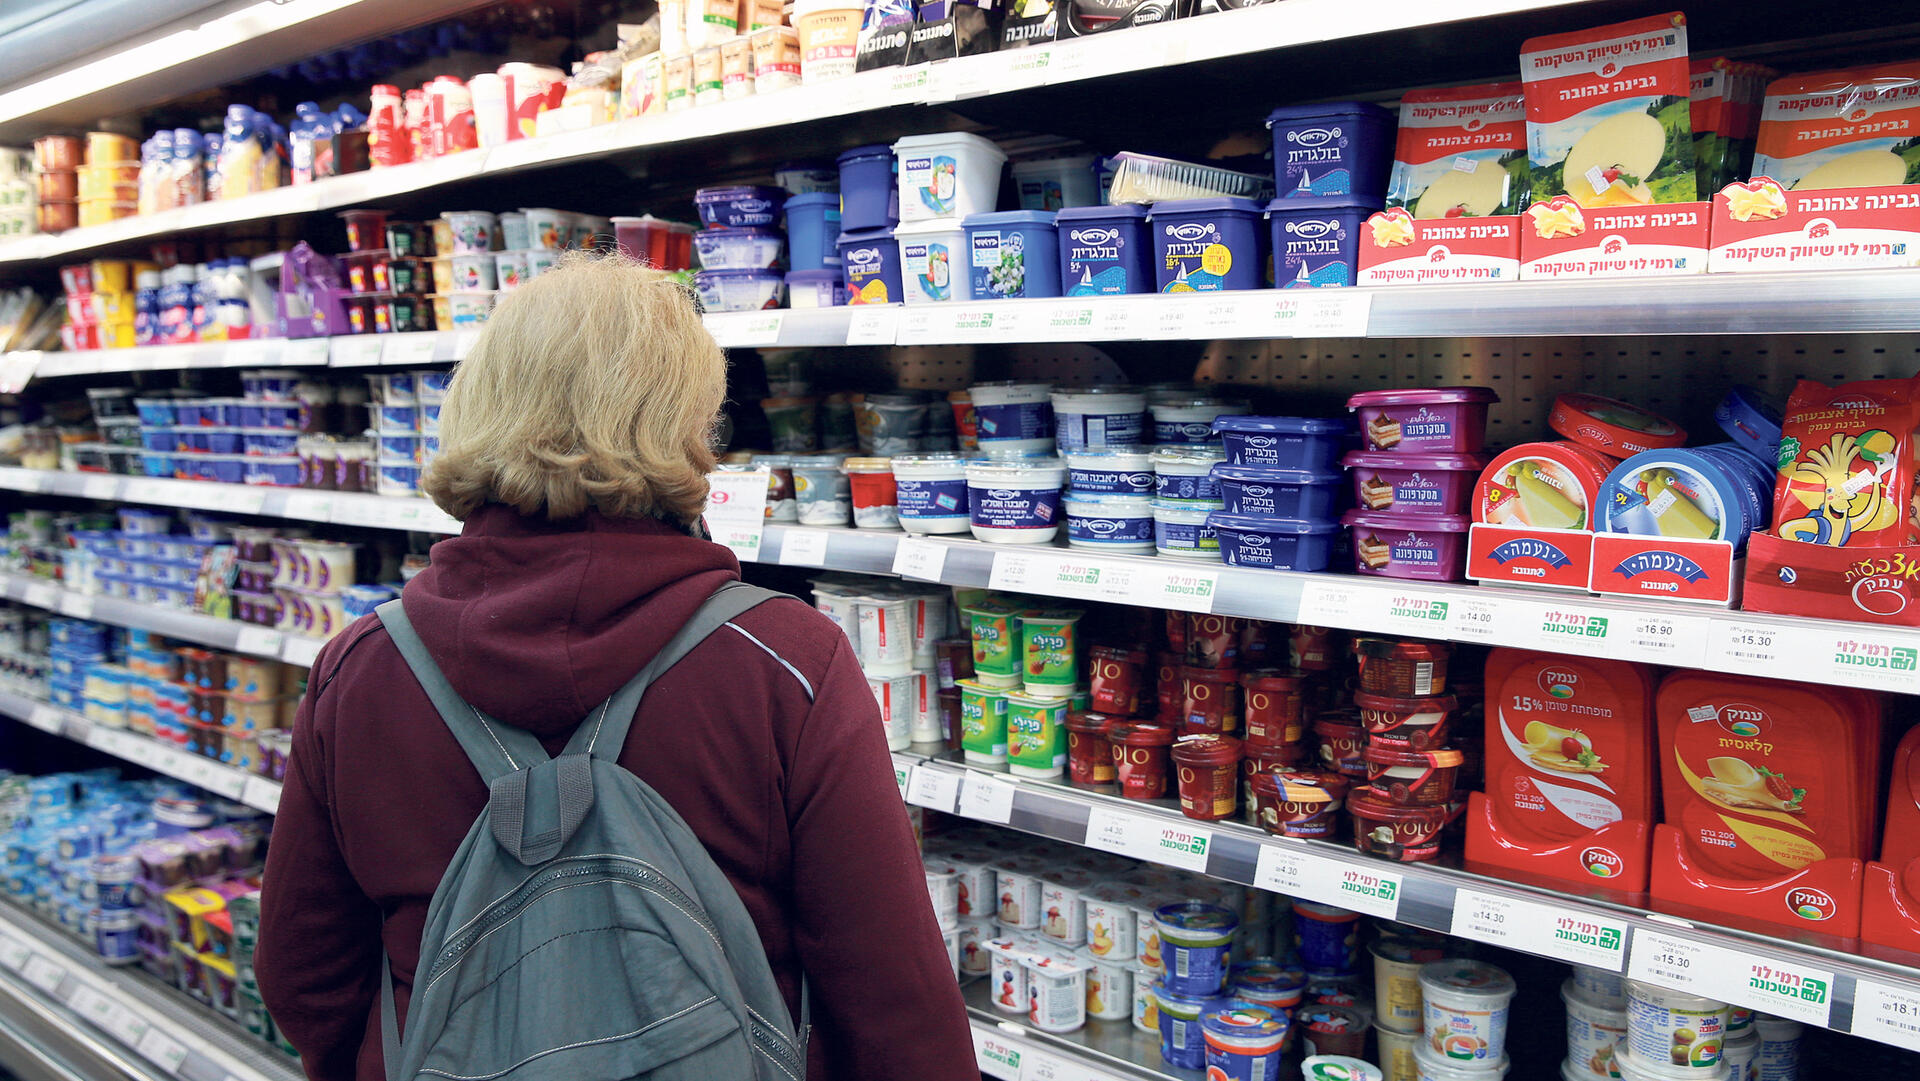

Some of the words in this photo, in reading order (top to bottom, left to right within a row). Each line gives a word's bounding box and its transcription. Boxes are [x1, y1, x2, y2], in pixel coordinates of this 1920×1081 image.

[913, 27, 944, 42] תנובה
[1006, 23, 1046, 41] תנובה
[1625, 38, 1641, 50] לוי
[1644, 36, 1665, 48] רמי
[1534, 51, 1585, 69] השקמה
[1588, 44, 1622, 62] שיווק
[1614, 76, 1657, 92] גבינה
[1560, 84, 1608, 101] צהובה
[1779, 96, 1834, 111] השקמה
[1412, 107, 1456, 120] השקמה
[1797, 126, 1854, 141] צהובה
[1859, 120, 1908, 133] גבינה
[1427, 136, 1470, 147] צהובה
[1473, 133, 1512, 144] גבינה
[1288, 147, 1341, 163] בולגרית
[1798, 196, 1859, 212] צהובה
[1865, 194, 1920, 209] גבינה
[1594, 216, 1645, 230] צהובה
[1651, 212, 1697, 226] גבינה
[1422, 227, 1466, 240] צהובה
[1470, 225, 1509, 239] גבינה
[1072, 246, 1118, 259] בולגרית
[1285, 239, 1339, 254] בולגרית
[1790, 245, 1834, 261] שיווק
[1838, 243, 1859, 256] לוי
[1863, 243, 1890, 255] רמי
[1726, 247, 1786, 262] השקמה
[1534, 262, 1585, 276] השקמה
[1590, 260, 1625, 275] שיווק
[1629, 258, 1646, 269] לוי
[1650, 258, 1672, 269] רמי
[1370, 270, 1414, 283] השקמה
[1417, 269, 1449, 282] שיווק
[1452, 267, 1467, 278] לוי
[1473, 268, 1489, 278] רמי
[1850, 406, 1885, 420] חטיף
[1407, 424, 1446, 434] מסקרפונה
[1808, 424, 1832, 434] עמק
[1835, 421, 1866, 430] גבינת
[1245, 447, 1278, 458] בולגרית
[1090, 473, 1117, 483] לאבנה
[1399, 489, 1438, 500] מסקרפונה
[1490, 489, 1501, 501] 8
[1005, 500, 1029, 508] לאבנה
[1242, 497, 1275, 508] בולגרית
[1239, 546, 1272, 557] בולגרית
[1396, 550, 1433, 560] מסקרפונה
[1509, 541, 1551, 559] נעמה
[1512, 566, 1537, 576] תנובה
[1637, 554, 1685, 574] נעמה
[1845, 553, 1920, 583] אצבעות
[1167, 575, 1180, 584] לוי
[1183, 576, 1196, 586] רמי
[1641, 580, 1668, 592] תנובה
[1864, 577, 1904, 594] עמק
[1165, 585, 1194, 595] בשכונה
[1392, 596, 1408, 608] לוי
[1411, 597, 1429, 609] רמי
[1390, 606, 1427, 619] בשכונה
[1545, 610, 1561, 623] לוי
[1566, 612, 1586, 625] רמי
[1542, 622, 1584, 636] בשכונה
[1033, 635, 1064, 650] פרילי
[1837, 640, 1858, 653] לוי
[1863, 642, 1889, 656] רמי
[1834, 653, 1887, 669] בשכונה
[1546, 671, 1577, 686] עמק
[1513, 695, 1543, 712] 15%
[1545, 701, 1569, 714] שומן
[1571, 703, 1612, 718] מופחתת
[1727, 708, 1763, 722] עמק
[1013, 716, 1041, 732] פרילי
[1719, 737, 1774, 755] קלאסית
[1276, 800, 1319, 817] YOLO
[1515, 800, 1539, 810] תנובה
[1162, 829, 1173, 840] לוי
[1176, 832, 1191, 844] רמי
[1701, 829, 1715, 838] גרם
[1717, 832, 1735, 840] 200
[1160, 838, 1190, 852] בשכונה
[1701, 836, 1727, 847] תנובה
[1588, 850, 1617, 865] עמק
[1344, 871, 1358, 884] לוי
[1361, 873, 1379, 887] רמי
[1341, 881, 1377, 896] בשכונה
[1795, 891, 1828, 906] עמק
[1557, 917, 1573, 933] לוי
[1577, 920, 1599, 935] רמי
[1554, 928, 1597, 945] בשכונה
[1752, 964, 1771, 979] לוי
[1775, 971, 1800, 986] רמי
[1750, 977, 1798, 998] בשכונה
[1882, 1002, 1920, 1016] ₪18.1
